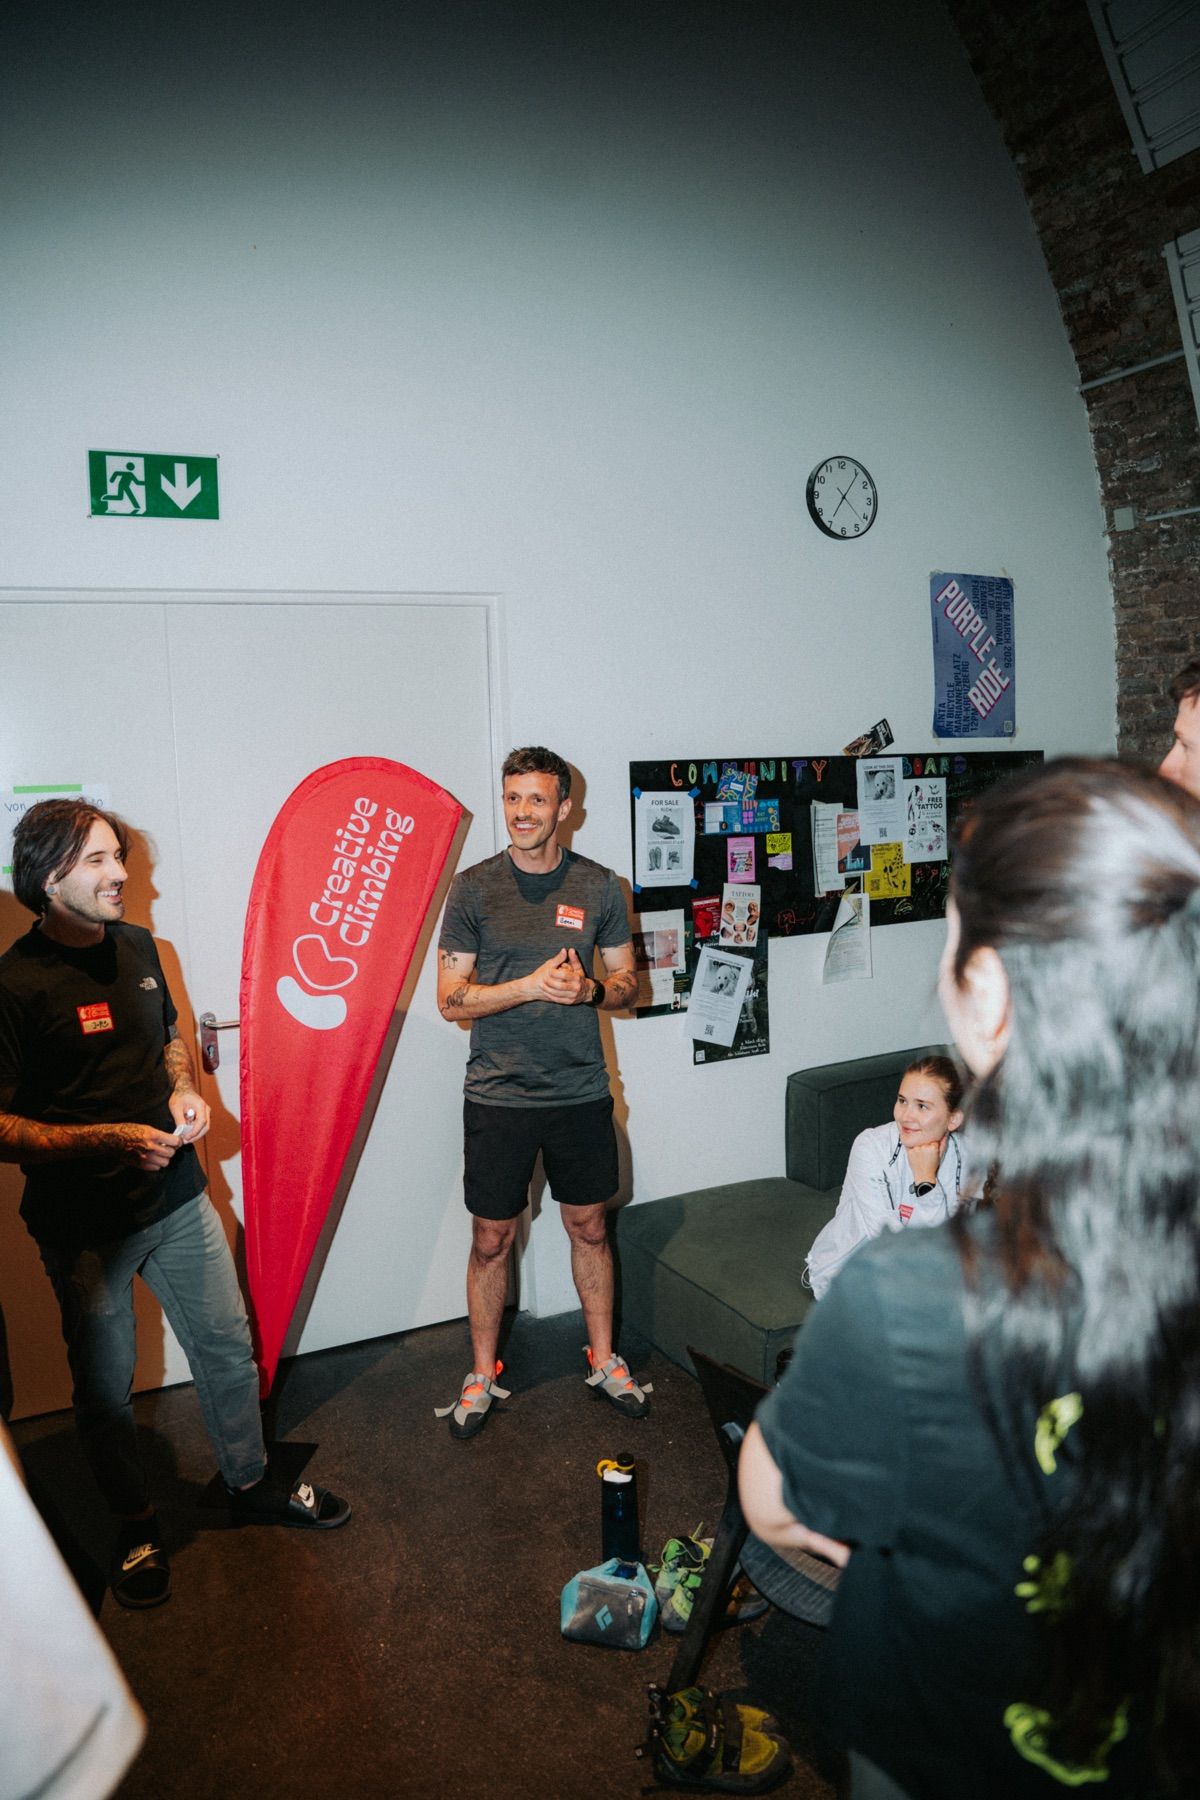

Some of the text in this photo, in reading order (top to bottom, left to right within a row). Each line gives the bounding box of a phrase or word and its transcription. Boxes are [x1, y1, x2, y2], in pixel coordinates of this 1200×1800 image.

[825, 465, 833, 473] 11
[838, 461, 847, 470] 12
[816, 476, 825, 485] 10
[862, 481, 868, 490] 2
[866, 497, 872, 506] 3
[841, 527, 847, 535] 6
[980, 581, 988, 620] FEMINIST
[988, 600, 995, 611] OF
[1003, 601, 1011, 613] OF
[936, 579, 997, 663] PURPLE
[995, 582, 1004, 647] INTERNATIONAL
[1003, 614, 1011, 643] MARCH
[1003, 646, 1012, 669] 2026
[953, 653, 962, 733] MARIANNENPLATZ
[967, 657, 1011, 719] RIDE
[946, 682, 955, 719] BICYCLE
[917, 802, 943, 810] TATTOO
[309, 797, 379, 926] Creative
[339, 808, 415, 946] Climbing
